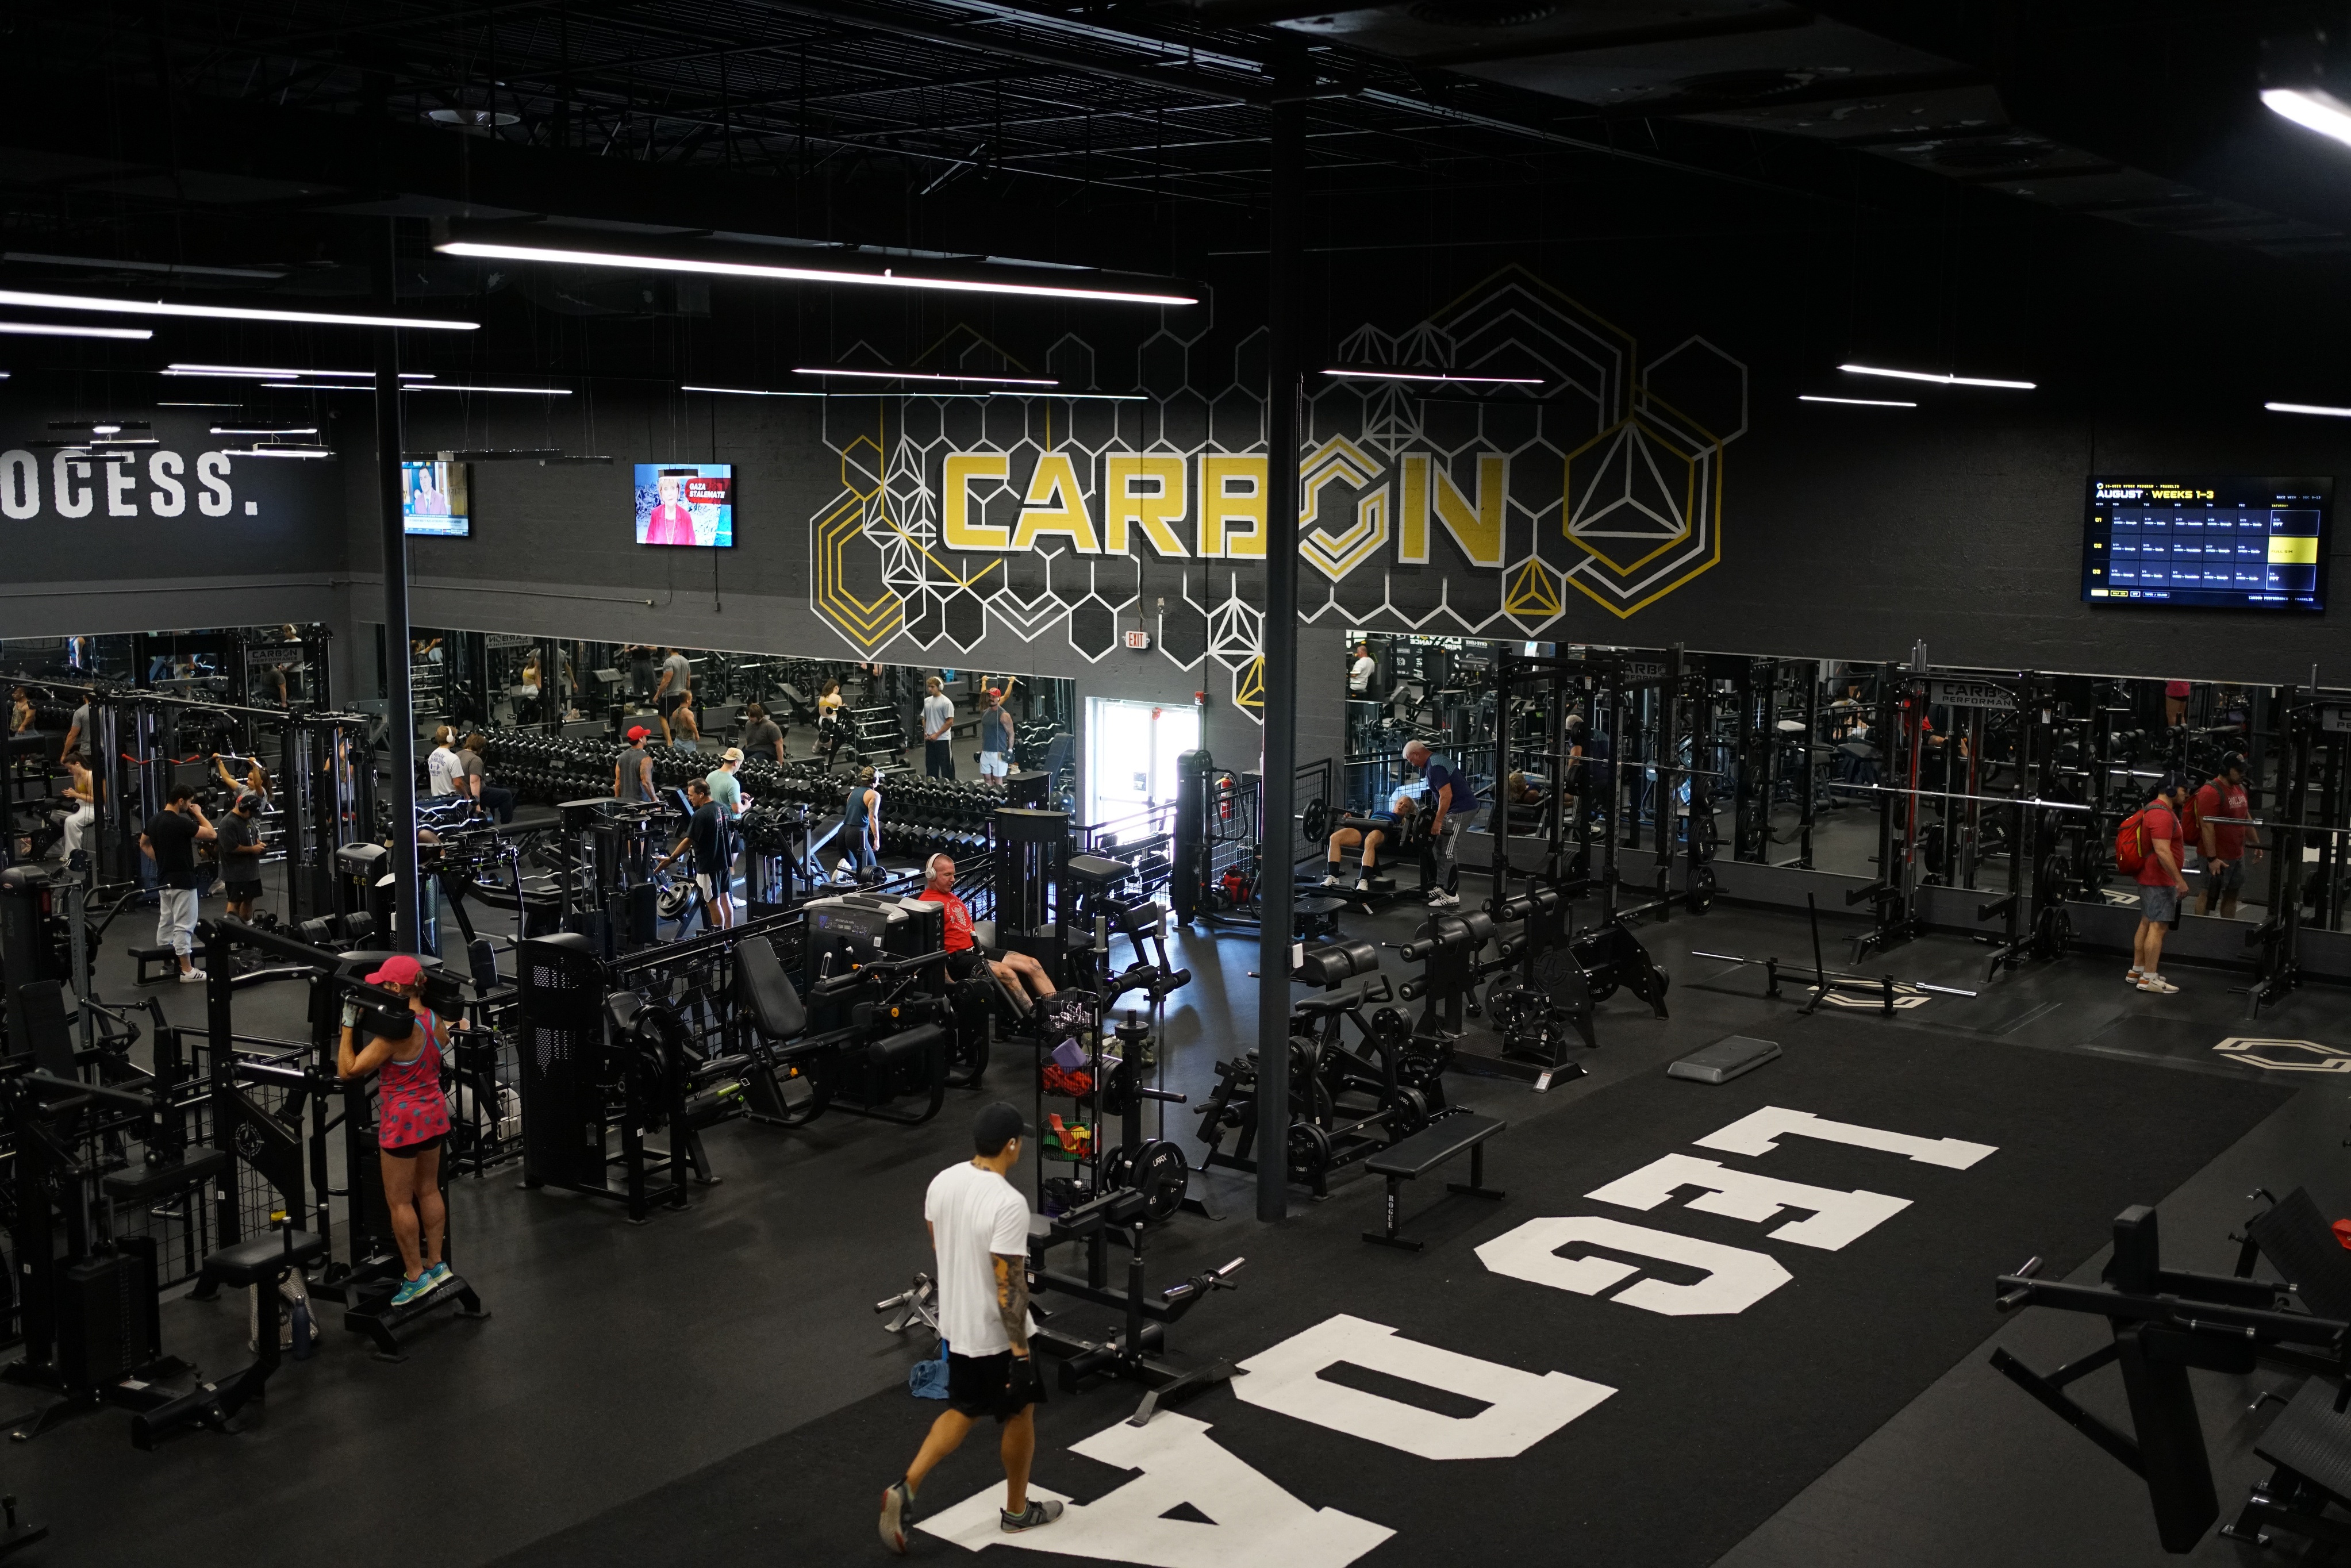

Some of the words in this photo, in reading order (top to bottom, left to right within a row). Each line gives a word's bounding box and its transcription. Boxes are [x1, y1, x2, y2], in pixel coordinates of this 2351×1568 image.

[0, 449, 258, 520] OCESS.
[689, 490, 725, 498] STALEMATE
[2096, 490, 2143, 498] AUGUST
[2152, 491, 2193, 499] WEEKS
[943, 433, 1508, 583] CARBON
[1130, 632, 1143, 647] EXIT
[252, 649, 297, 658] CARBON
[1624, 663, 1666, 677] ARBO
[1943, 683, 2011, 700] CARBO
[1942, 695, 2011, 706] PERFORMAN
[1111, 1080, 1117, 1089] 25
[1399, 1095, 1410, 1106] UMAX
[1401, 1123, 1410, 1132] 11.4
[1153, 1153, 1167, 1167] UMAX
[1109, 1160, 1117, 1174] UMAX
[1150, 1196, 1157, 1205] 45
[1475, 1105, 1999, 1316] LEG
